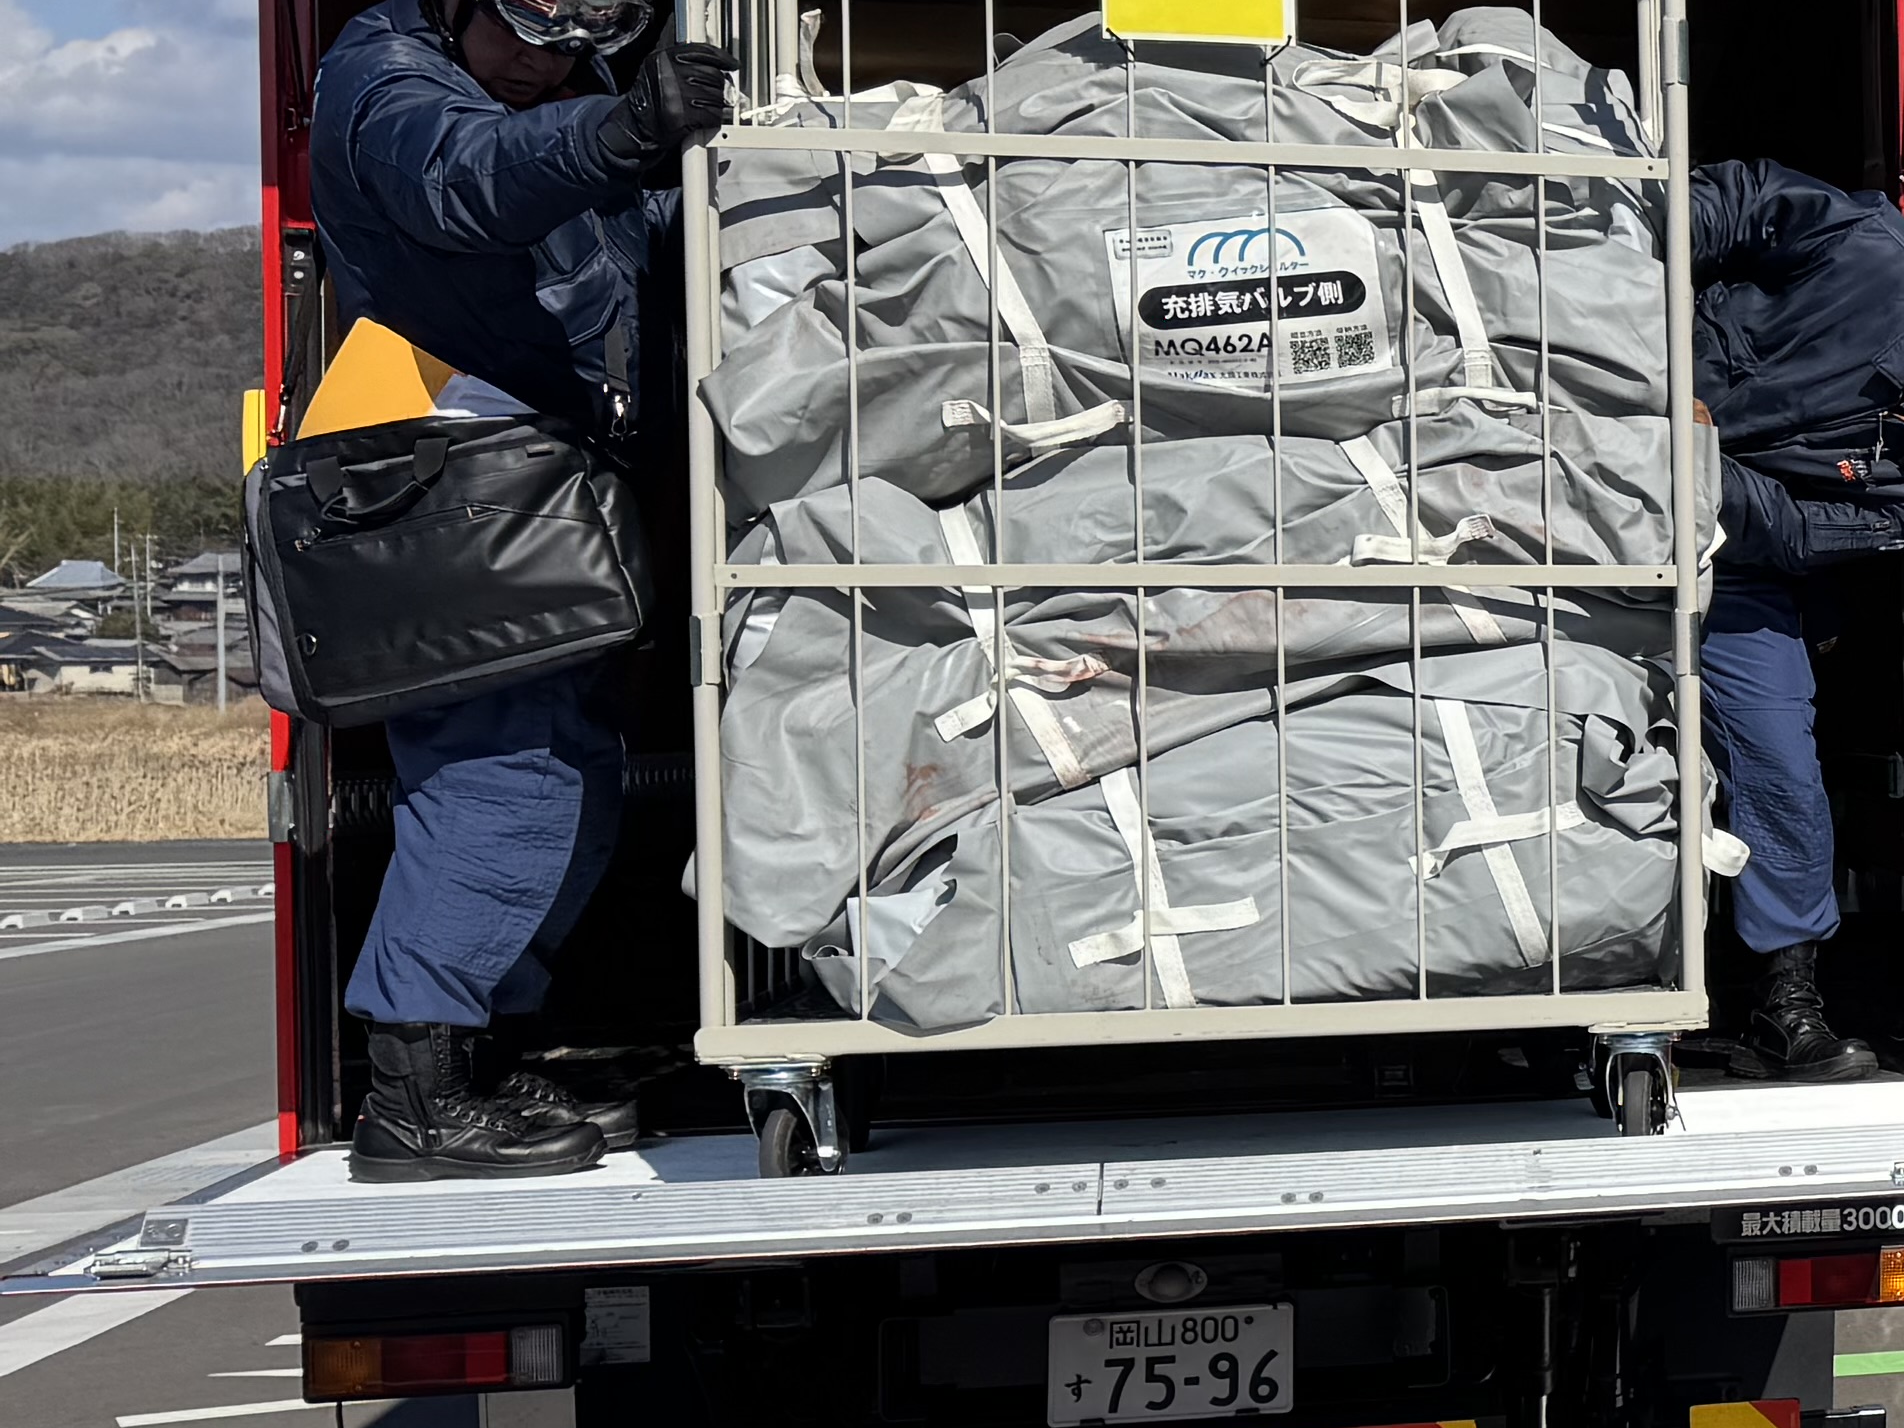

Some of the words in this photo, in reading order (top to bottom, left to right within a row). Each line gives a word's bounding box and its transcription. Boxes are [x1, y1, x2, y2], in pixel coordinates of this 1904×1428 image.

[1187, 260, 1309, 279] マク・クイックシルター
[1161, 279, 1344, 321] 充排気バルブ側
[1154, 332, 1272, 358] MQ462A
[1064, 1373, 1093, 1403] す
[1103, 1348, 1280, 1414] 75-96
